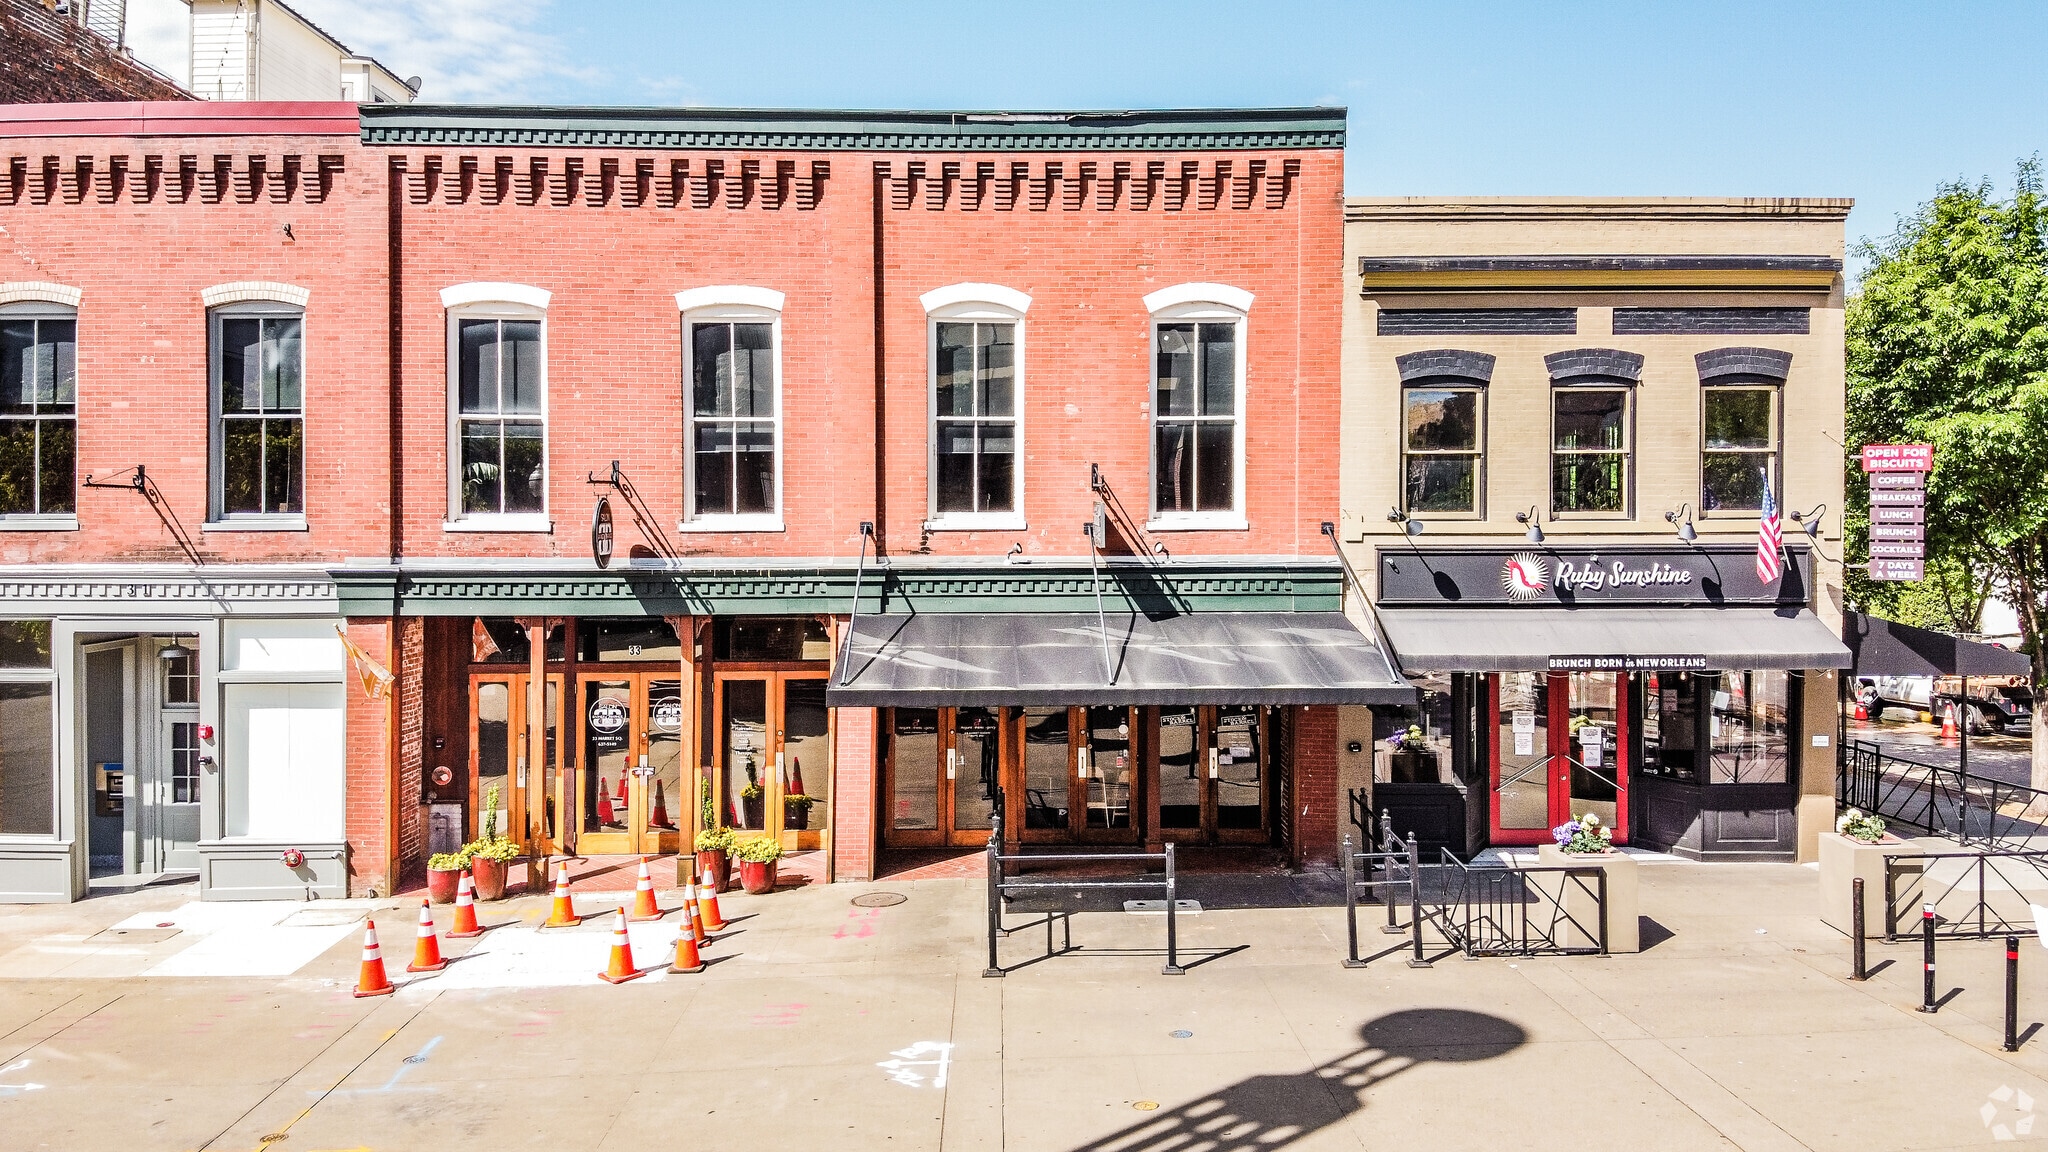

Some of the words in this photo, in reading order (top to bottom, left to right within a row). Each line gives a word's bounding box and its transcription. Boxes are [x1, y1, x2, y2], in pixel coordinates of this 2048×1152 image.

[1865, 448, 1899, 458] OPEN
[1902, 448, 1929, 457] FOR
[1870, 459, 1924, 468] BISCUITS
[1877, 476, 1916, 484] COFFEE
[1879, 511, 1913, 519] LUNCH
[1876, 528, 1917, 536] BRUNCH
[1871, 545, 1922, 553] COCKTAILS
[1887, 562, 1915, 570] DAYS
[1554, 561, 1606, 591] Ruby
[1608, 561, 1692, 587] Sunshine
[1887, 571, 1917, 579] WEEK
[629, 645, 641, 656] 33
[1549, 658, 1592, 668] BRUNCH
[1594, 658, 1623, 668] BORN
[1625, 656, 1635, 668] in
